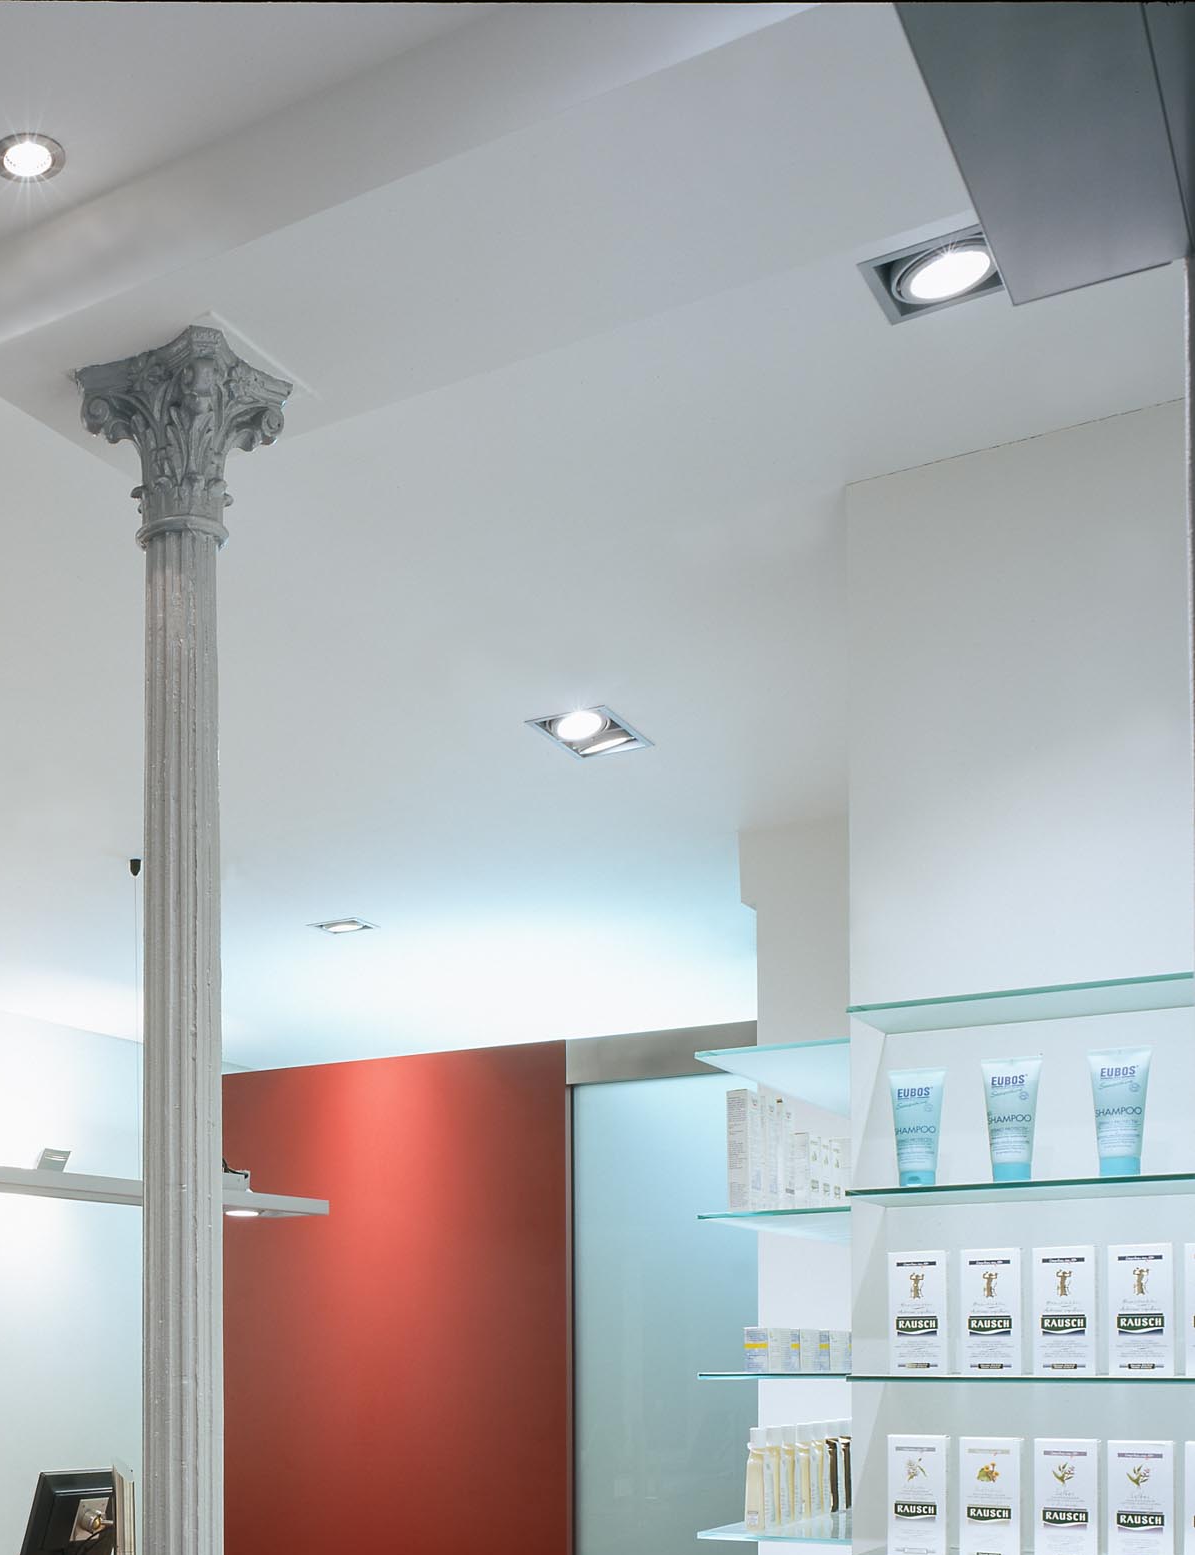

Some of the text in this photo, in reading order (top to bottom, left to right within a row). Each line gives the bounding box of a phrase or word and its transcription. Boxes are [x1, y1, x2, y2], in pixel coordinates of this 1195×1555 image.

[1100, 1065, 1136, 1078] EUBOS
[991, 1074, 1025, 1086] EUBOS
[897, 1086, 931, 1098] EUBOS
[899, 1319, 936, 1329] RAUSCH
[971, 1319, 1010, 1329] RAUSCH
[1044, 1318, 1084, 1328] RAUSCH
[1120, 1317, 1162, 1327] RAUSCH
[897, 1504, 935, 1514] RAUSCH
[970, 1508, 1009, 1518] RAUSCH
[1045, 1511, 1087, 1522] RAUSCH
[1120, 1514, 1163, 1525] RAUSCH
